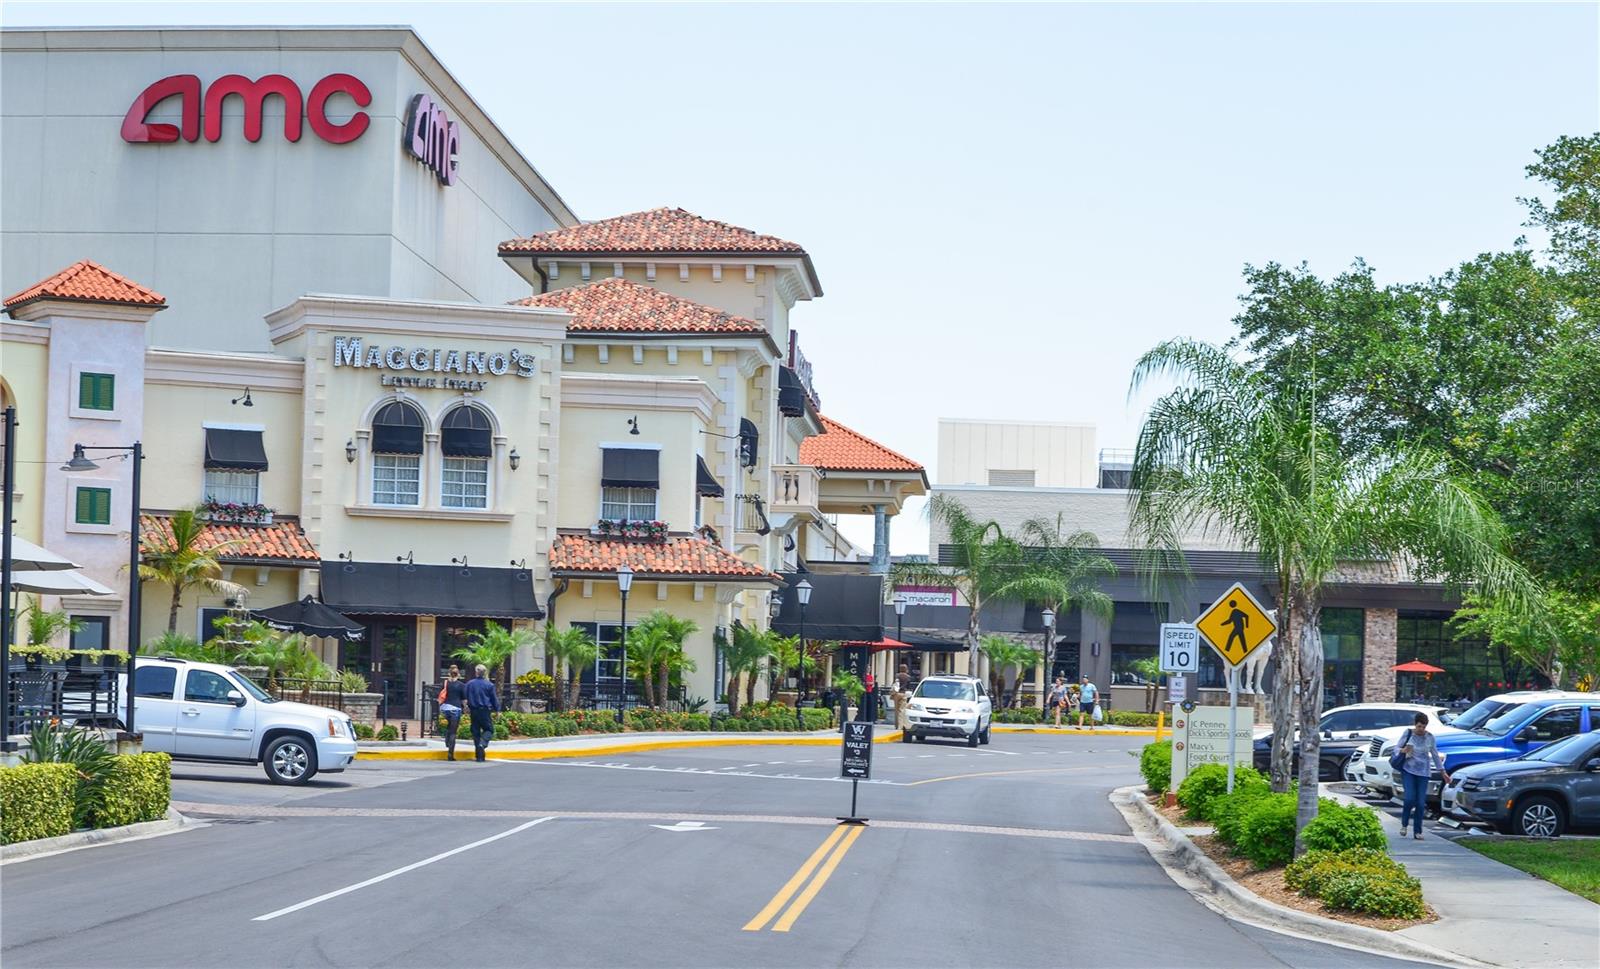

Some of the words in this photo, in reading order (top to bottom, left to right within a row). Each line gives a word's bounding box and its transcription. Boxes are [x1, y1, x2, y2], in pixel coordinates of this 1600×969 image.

[1166, 631, 1195, 640] SPEED
[1169, 641, 1191, 649] LIMIT
[1169, 651, 1190, 667] 10
[1190, 720, 1198, 728] JC
[1200, 720, 1226, 729] Penney
[1235, 730, 1251, 738] oods
[846, 741, 869, 749] VALET
[1190, 743, 1214, 752] Macy's
[1189, 752, 1207, 761] Food
[1209, 753, 1230, 761] Court
